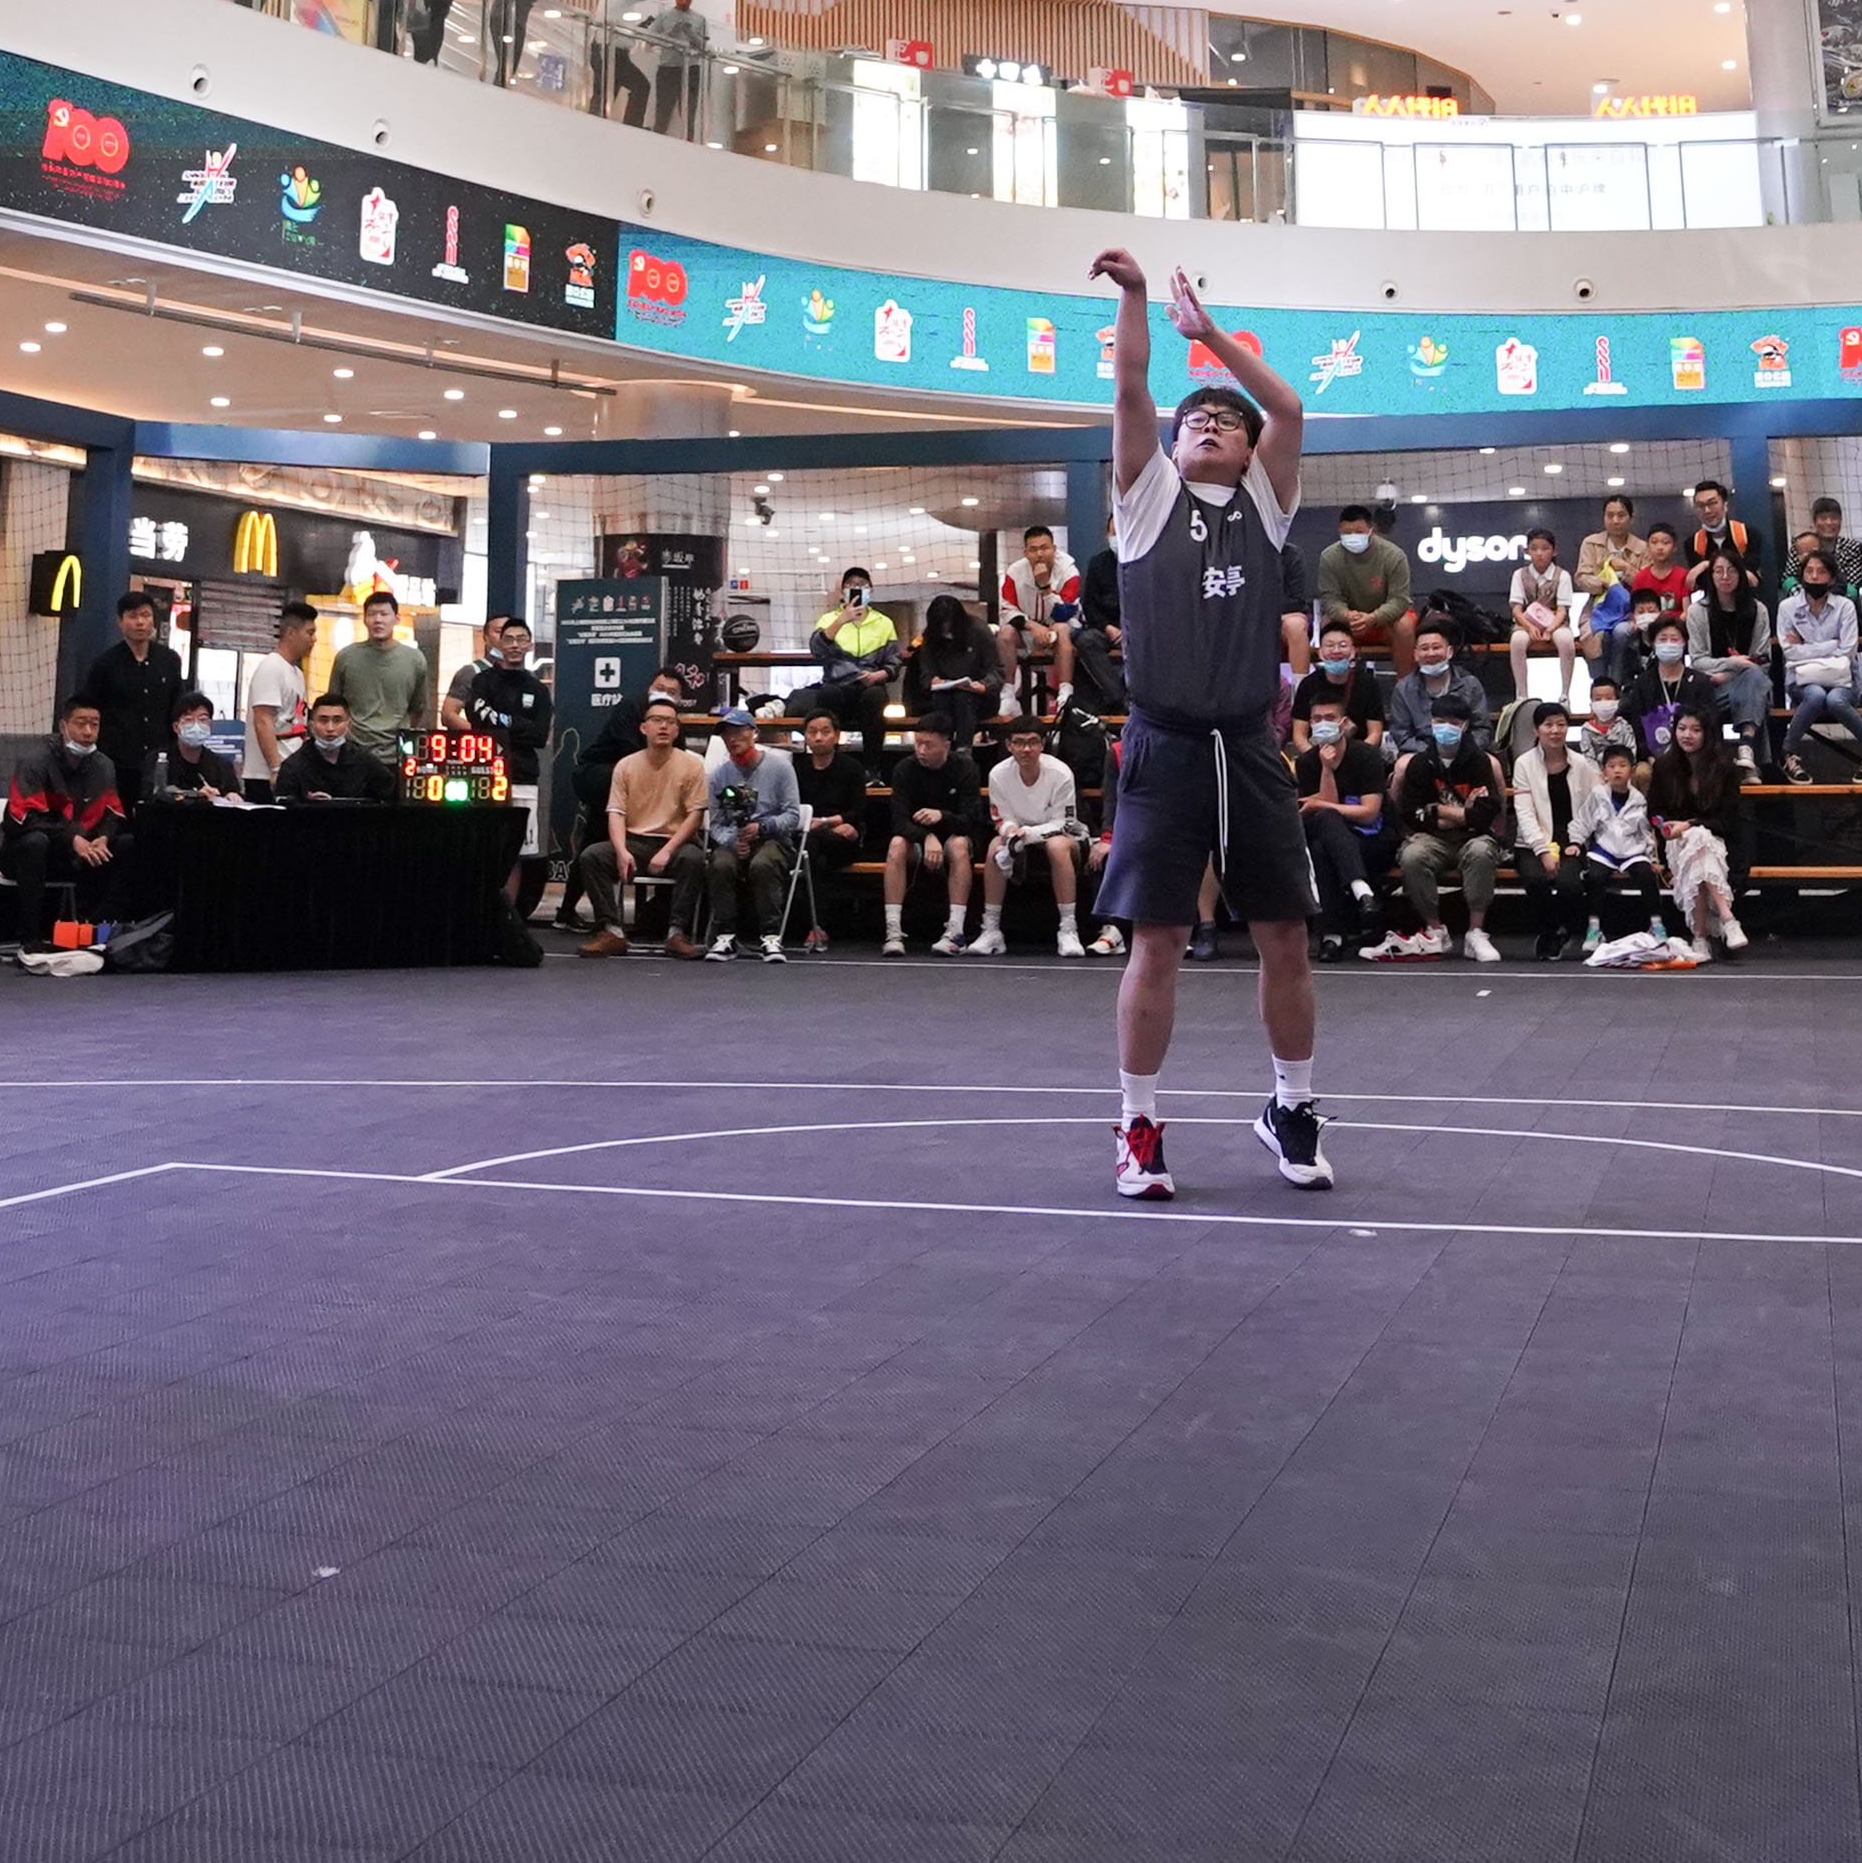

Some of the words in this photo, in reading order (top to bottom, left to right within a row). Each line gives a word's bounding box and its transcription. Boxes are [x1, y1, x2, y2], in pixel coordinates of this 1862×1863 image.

[1189, 508, 1209, 543] 5
[1200, 564, 1247, 600] 安亭
[430, 733, 493, 763] 9:04
